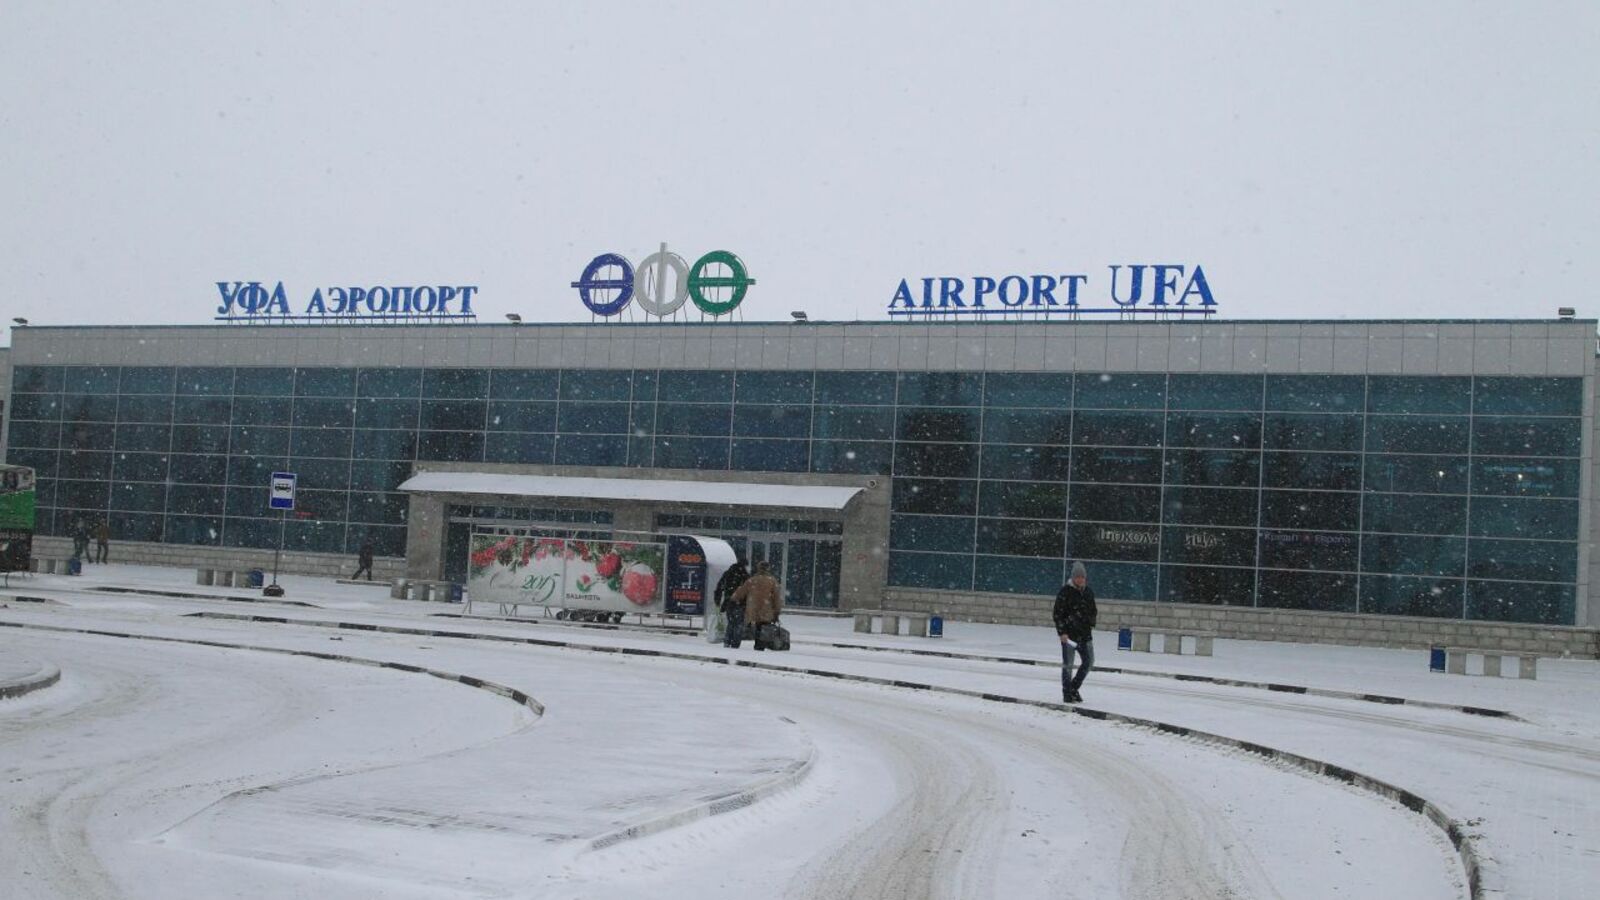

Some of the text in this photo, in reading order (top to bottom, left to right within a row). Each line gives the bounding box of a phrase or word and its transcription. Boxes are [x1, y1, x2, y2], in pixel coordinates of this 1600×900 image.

[216, 281, 479, 314] УФА АЭРОПОРТ
[888, 265, 1218, 308] AIRPORT UFA
